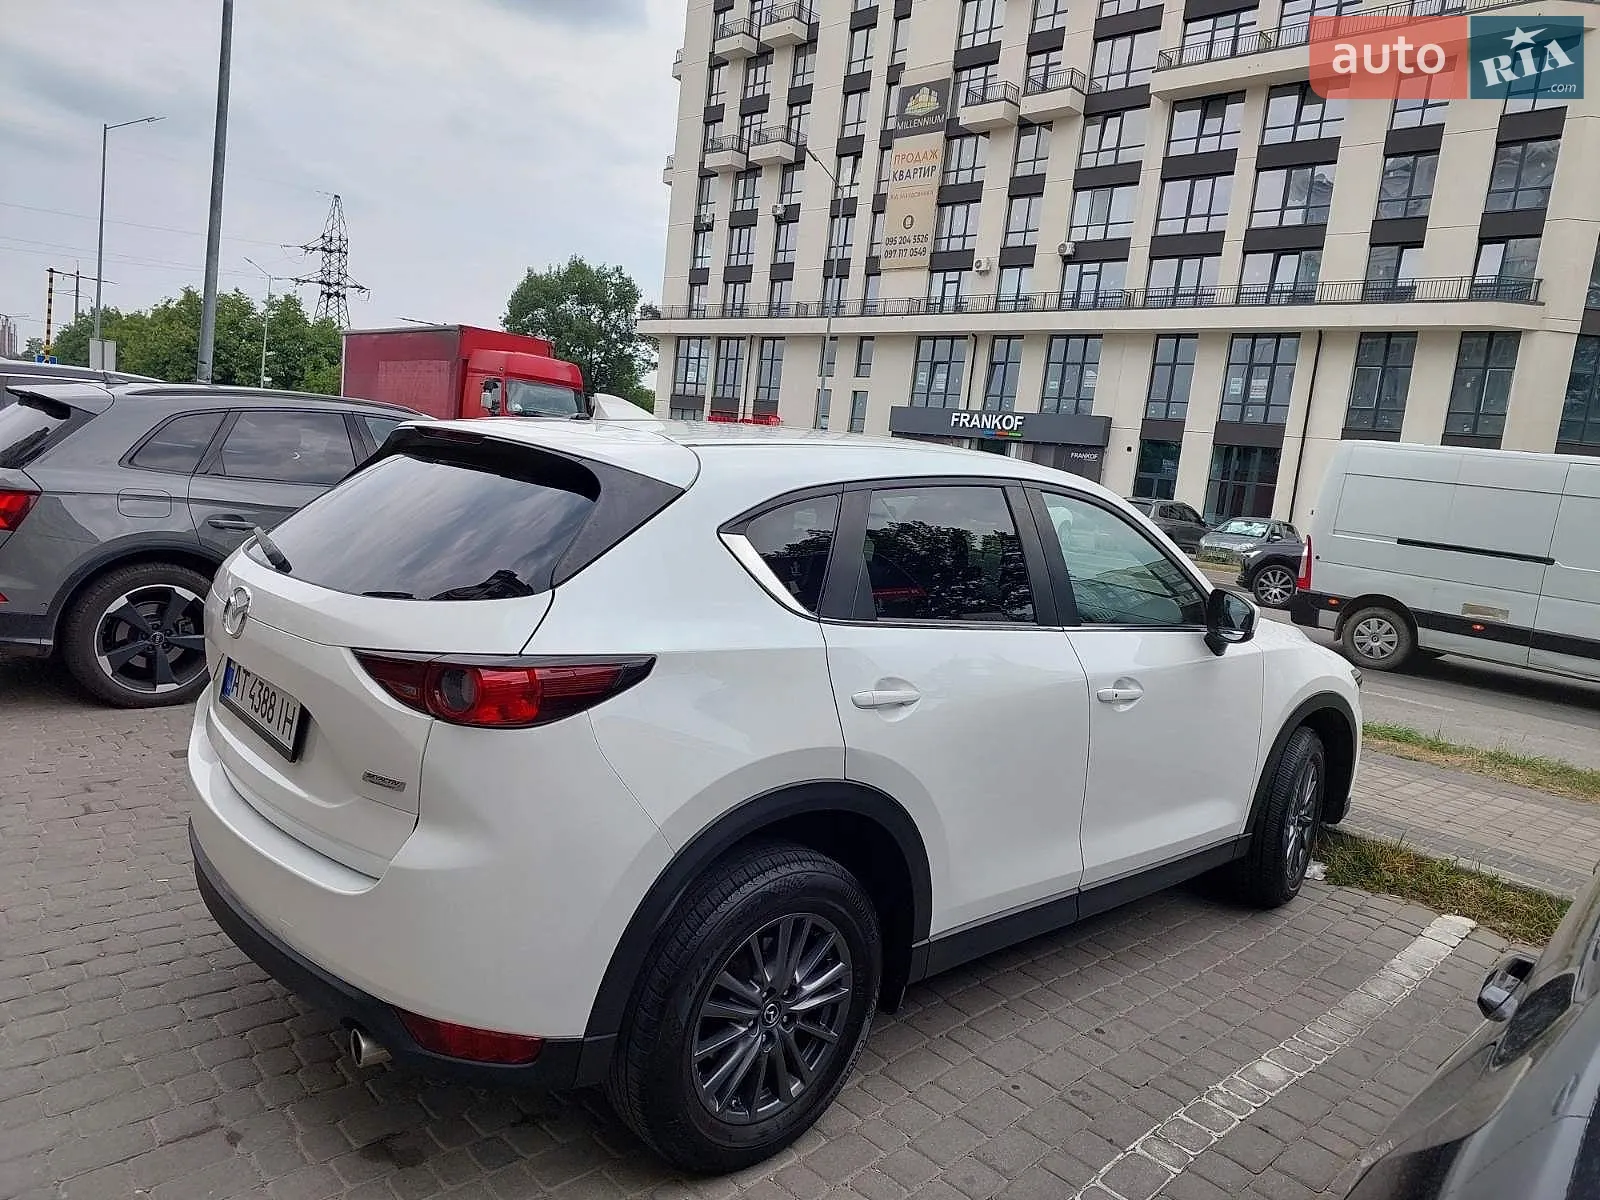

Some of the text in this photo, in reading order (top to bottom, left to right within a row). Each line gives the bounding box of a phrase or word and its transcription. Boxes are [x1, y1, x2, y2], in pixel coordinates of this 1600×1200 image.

[896, 114, 945, 130] MILLENNIUM
[894, 149, 938, 165] ПРОДАЖ
[892, 165, 937, 182] КВАРТИР
[885, 236, 898, 246] 095
[898, 235, 911, 245] 204
[884, 249, 897, 259] 097
[909, 246, 927, 257] 0549
[950, 412, 1025, 431] FRANKOF
[1070, 452, 1098, 460] FRANKOF
[231, 665, 296, 741] AT 4388 IH
